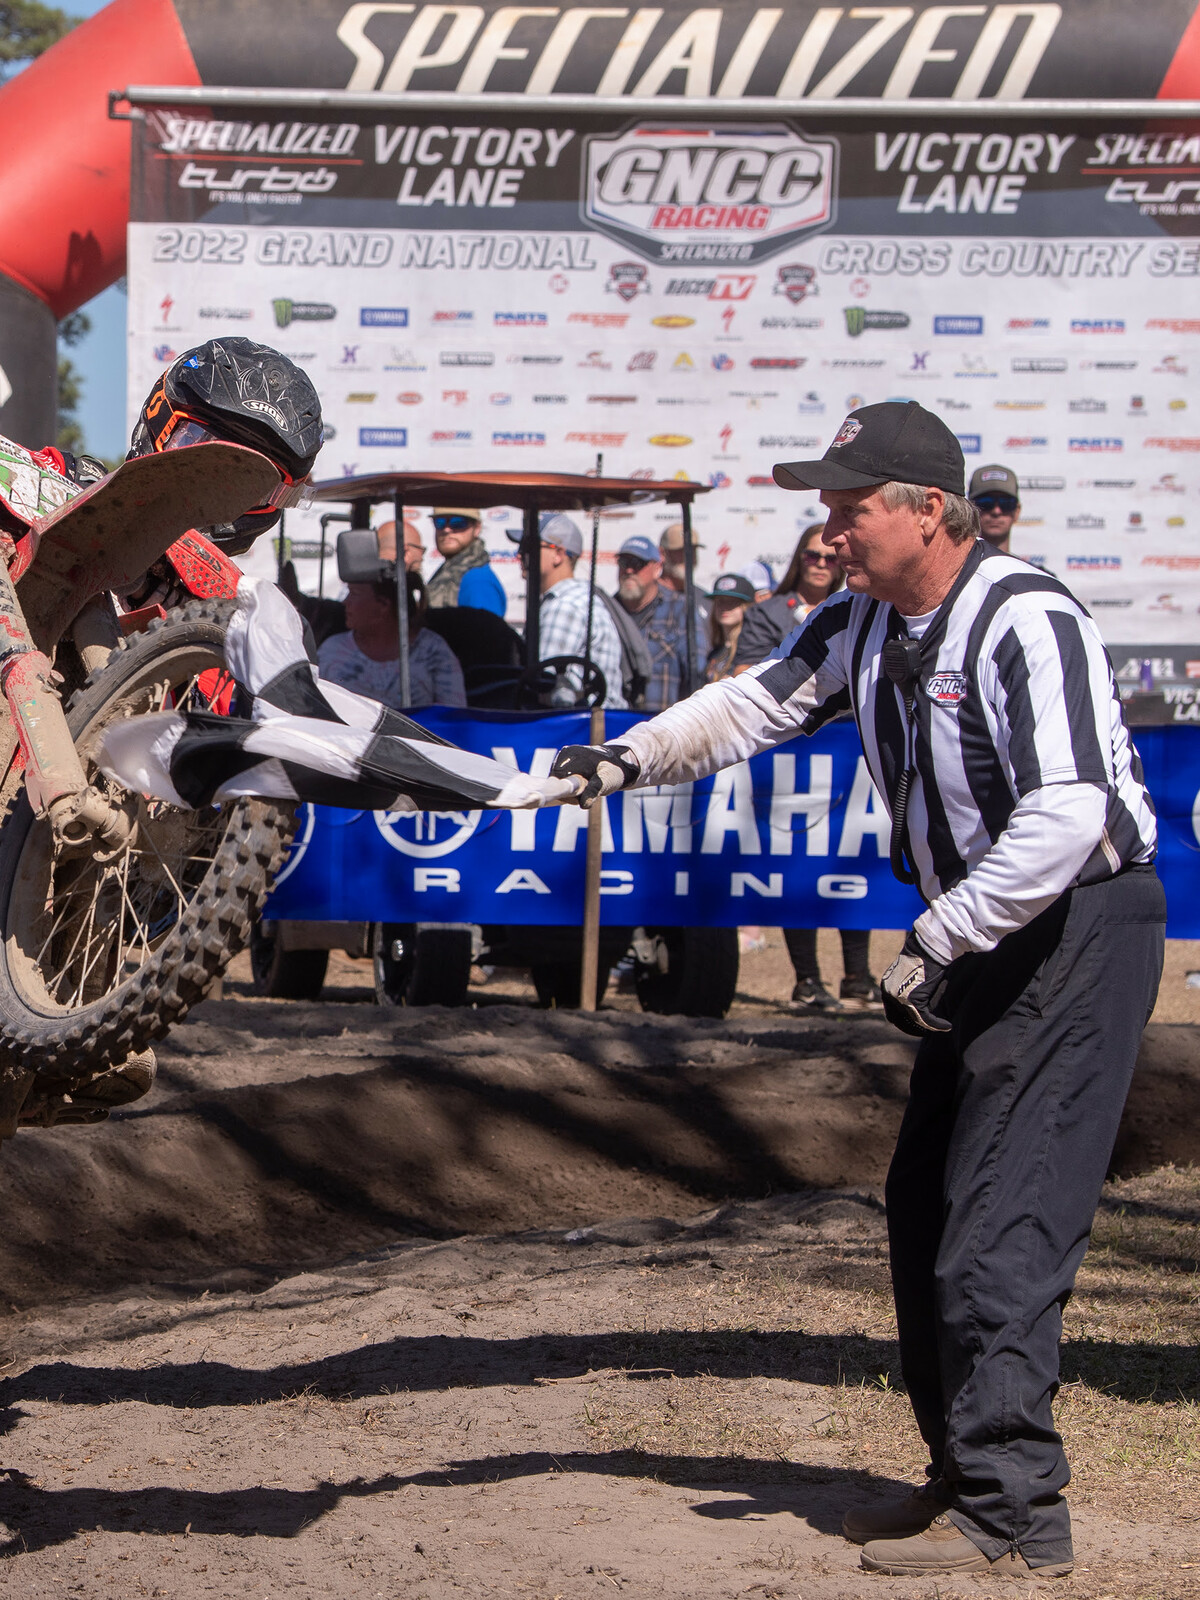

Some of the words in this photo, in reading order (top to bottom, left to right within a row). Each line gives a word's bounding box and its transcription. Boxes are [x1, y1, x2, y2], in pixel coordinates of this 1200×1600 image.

[337, 2, 1062, 97] SPECIALIZED
[160, 119, 359, 154] SPECIALIZED
[374, 126, 575, 167] VICTORY
[875, 132, 1075, 173] VICTORY
[1086, 133, 1200, 165] SPECIA
[178, 163, 338, 193] turbo
[397, 168, 525, 208] LANE
[598, 145, 823, 207] GNCC
[897, 175, 1027, 215] LANE
[1105, 177, 1200, 203] tur
[651, 205, 771, 230] RACING
[153, 228, 246, 266] 2022
[255, 230, 392, 269] GRAND
[400, 232, 597, 271] NATIONAL
[818, 240, 952, 277] CROSS
[958, 241, 1141, 278] COUNTRY
[250, 401, 285, 428] SHOEI
[927, 679, 966, 693] GNCC
[491, 747, 893, 858] YAMAHA
[413, 867, 868, 899] RACING
